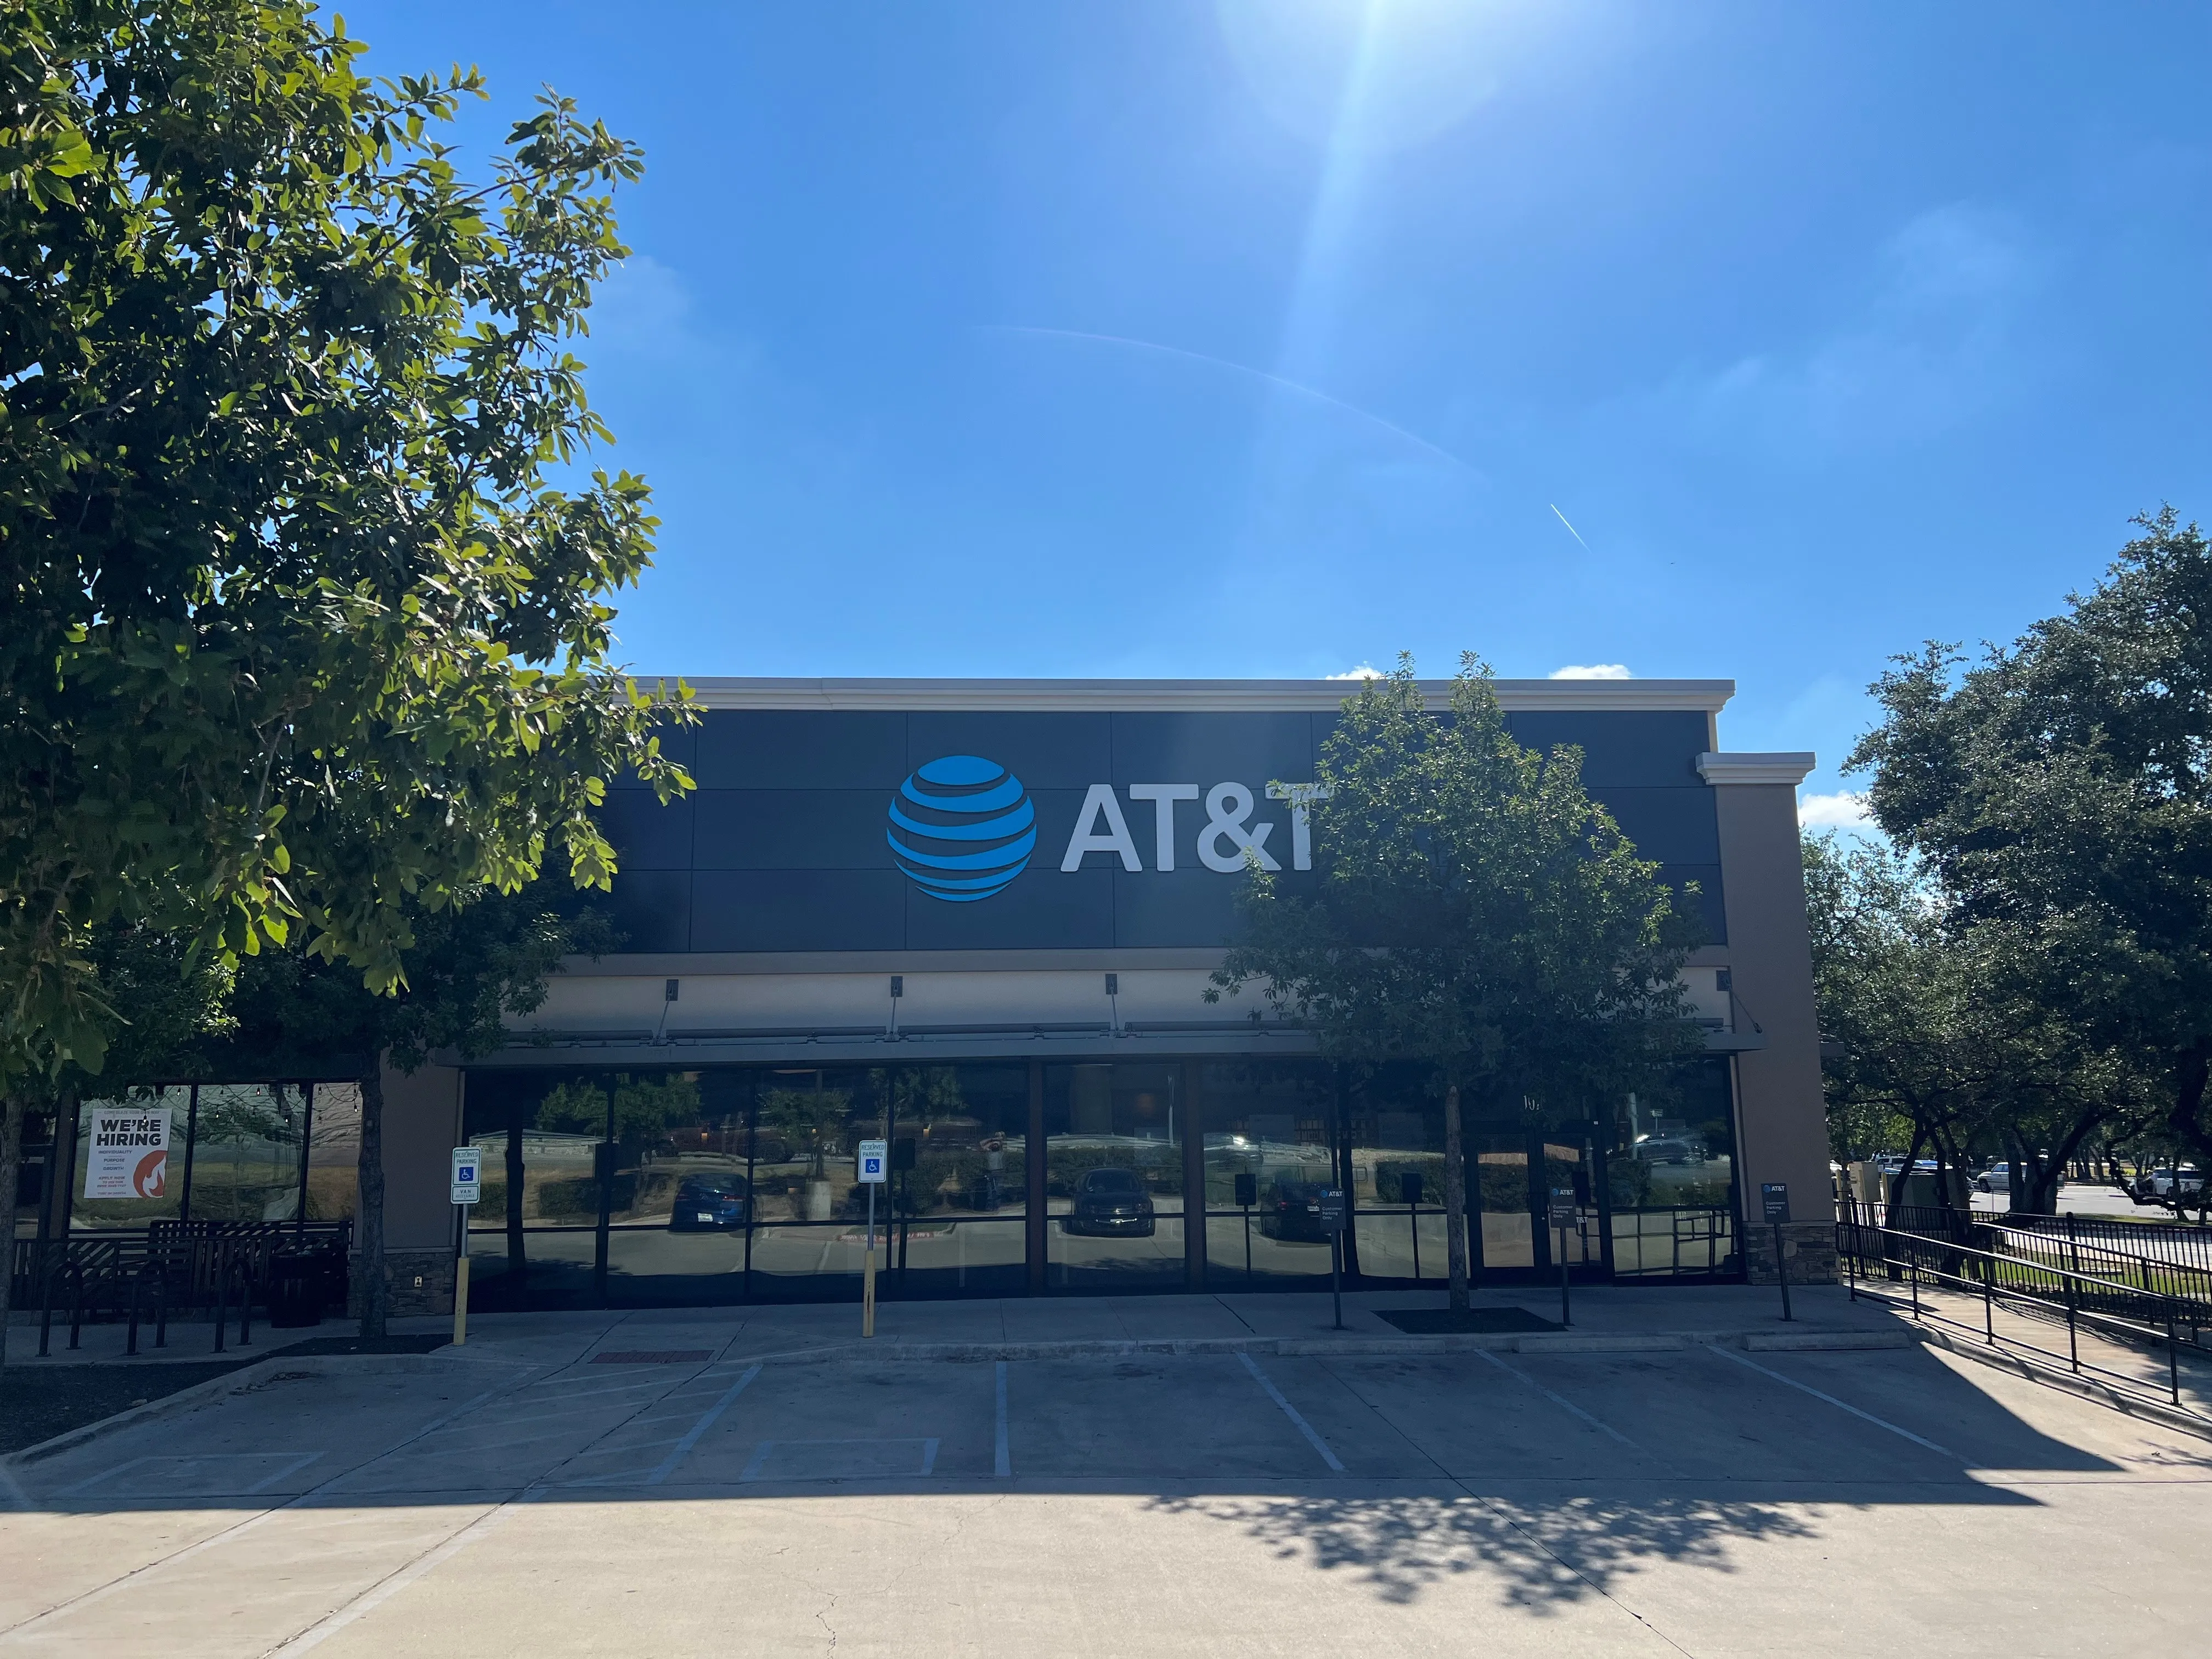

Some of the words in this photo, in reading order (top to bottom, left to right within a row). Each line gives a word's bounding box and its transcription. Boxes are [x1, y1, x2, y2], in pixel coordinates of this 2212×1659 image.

[1060, 781, 1333, 873] AT&T
[100, 1119, 161, 1132] WE'RE
[96, 1133, 161, 1146] HIRING
